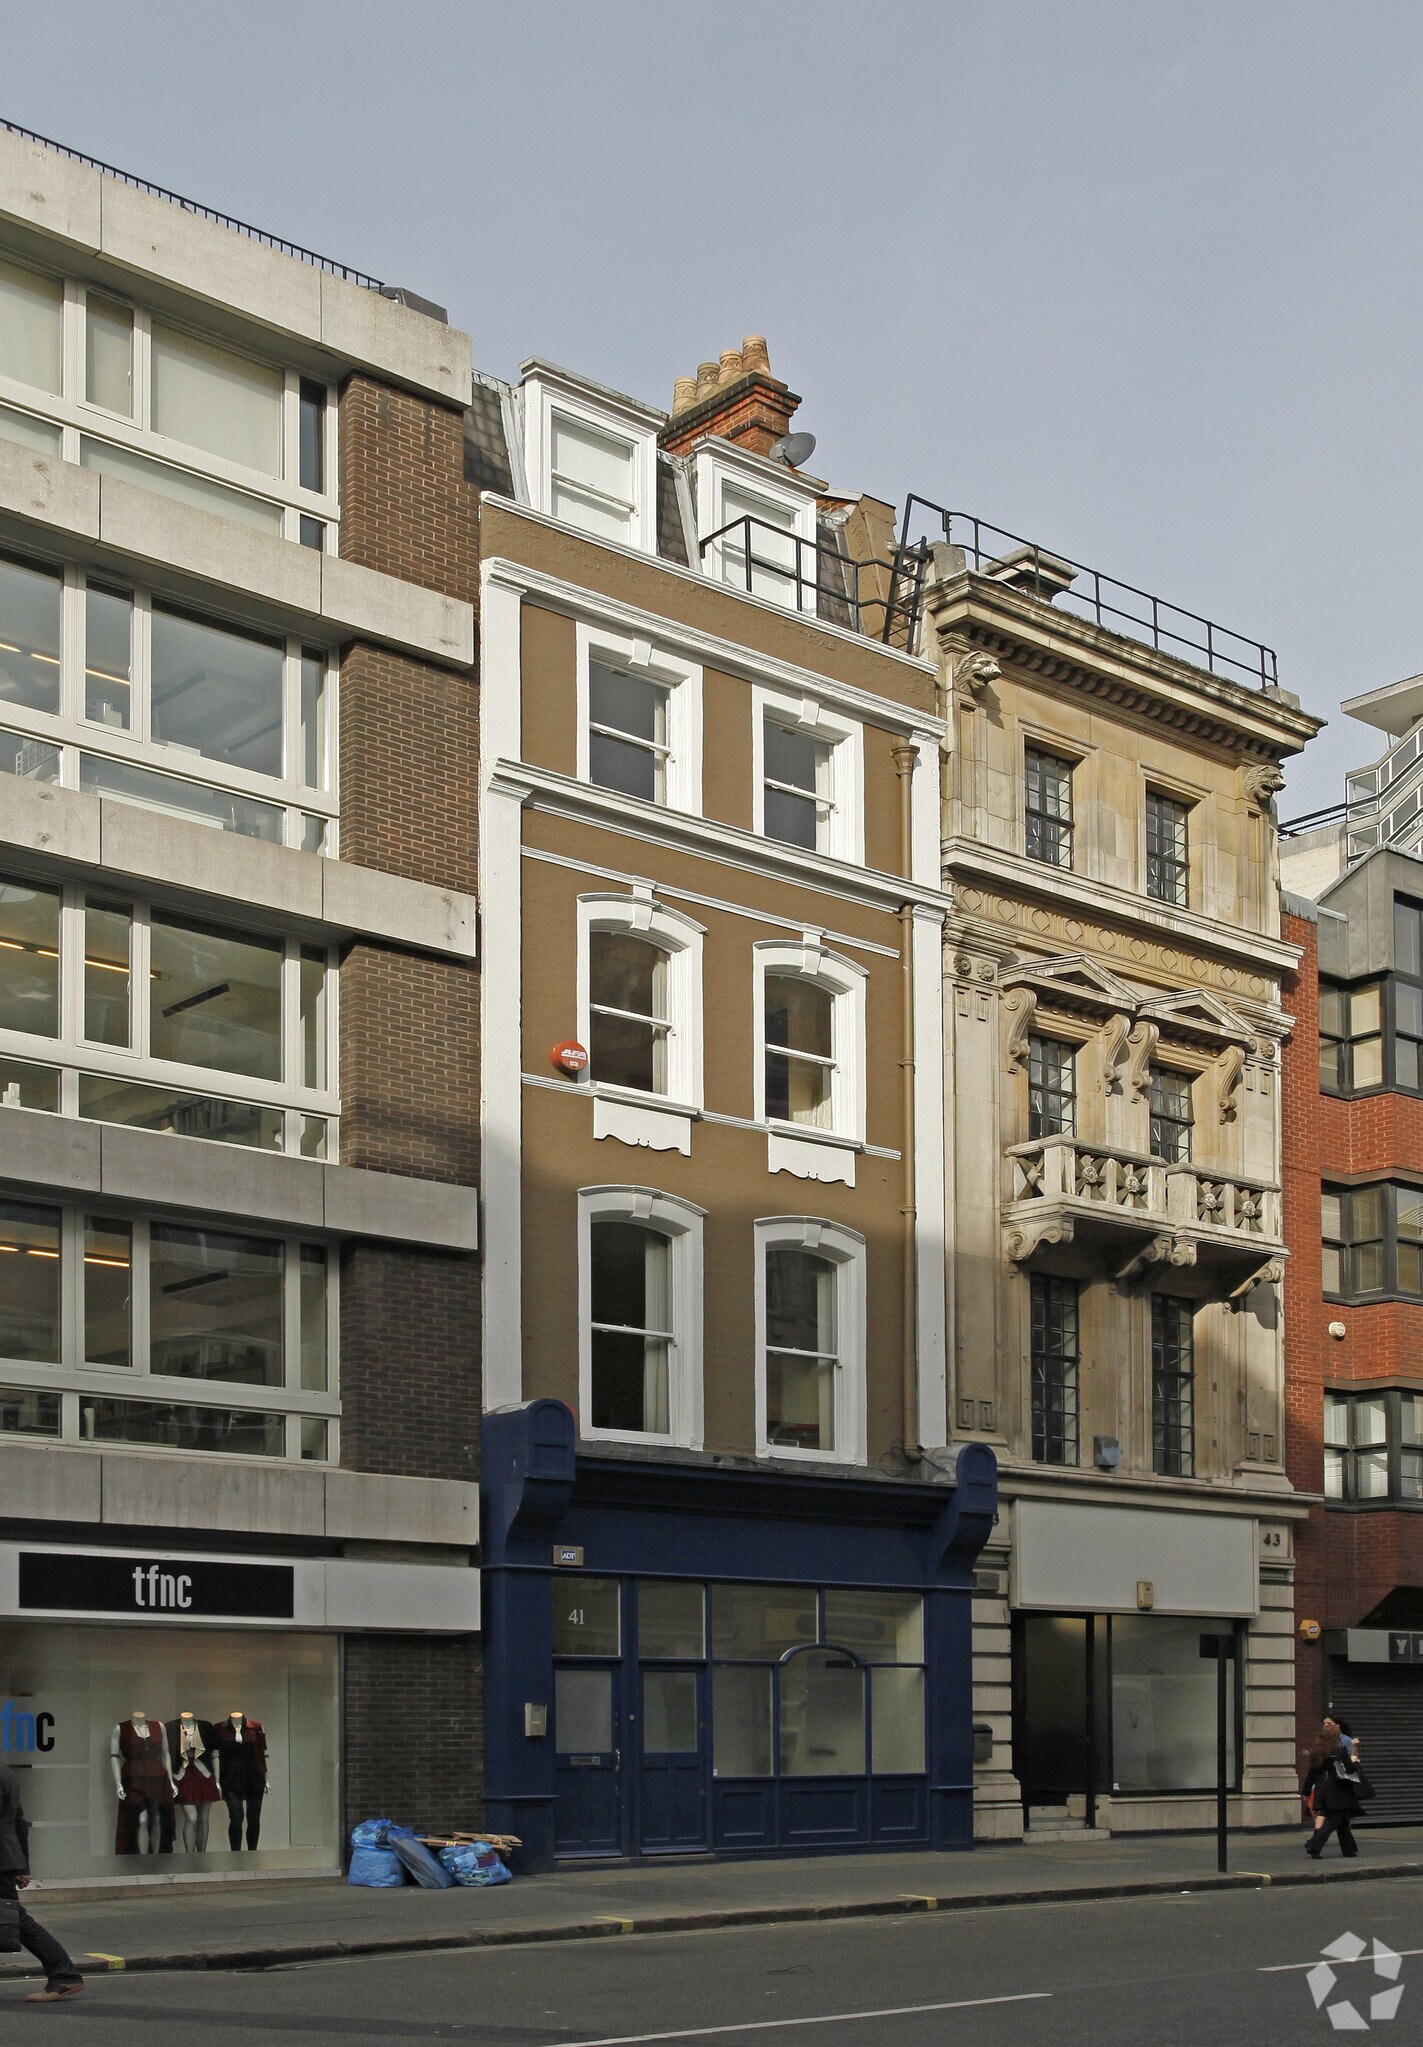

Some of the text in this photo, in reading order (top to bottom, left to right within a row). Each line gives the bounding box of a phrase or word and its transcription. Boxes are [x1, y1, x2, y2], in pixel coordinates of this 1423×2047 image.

[1263, 1532, 1281, 1547] 43
[561, 1552, 576, 1560] ADT
[132, 1564, 192, 1608] tfnc
[568, 1608, 585, 1625] 41
